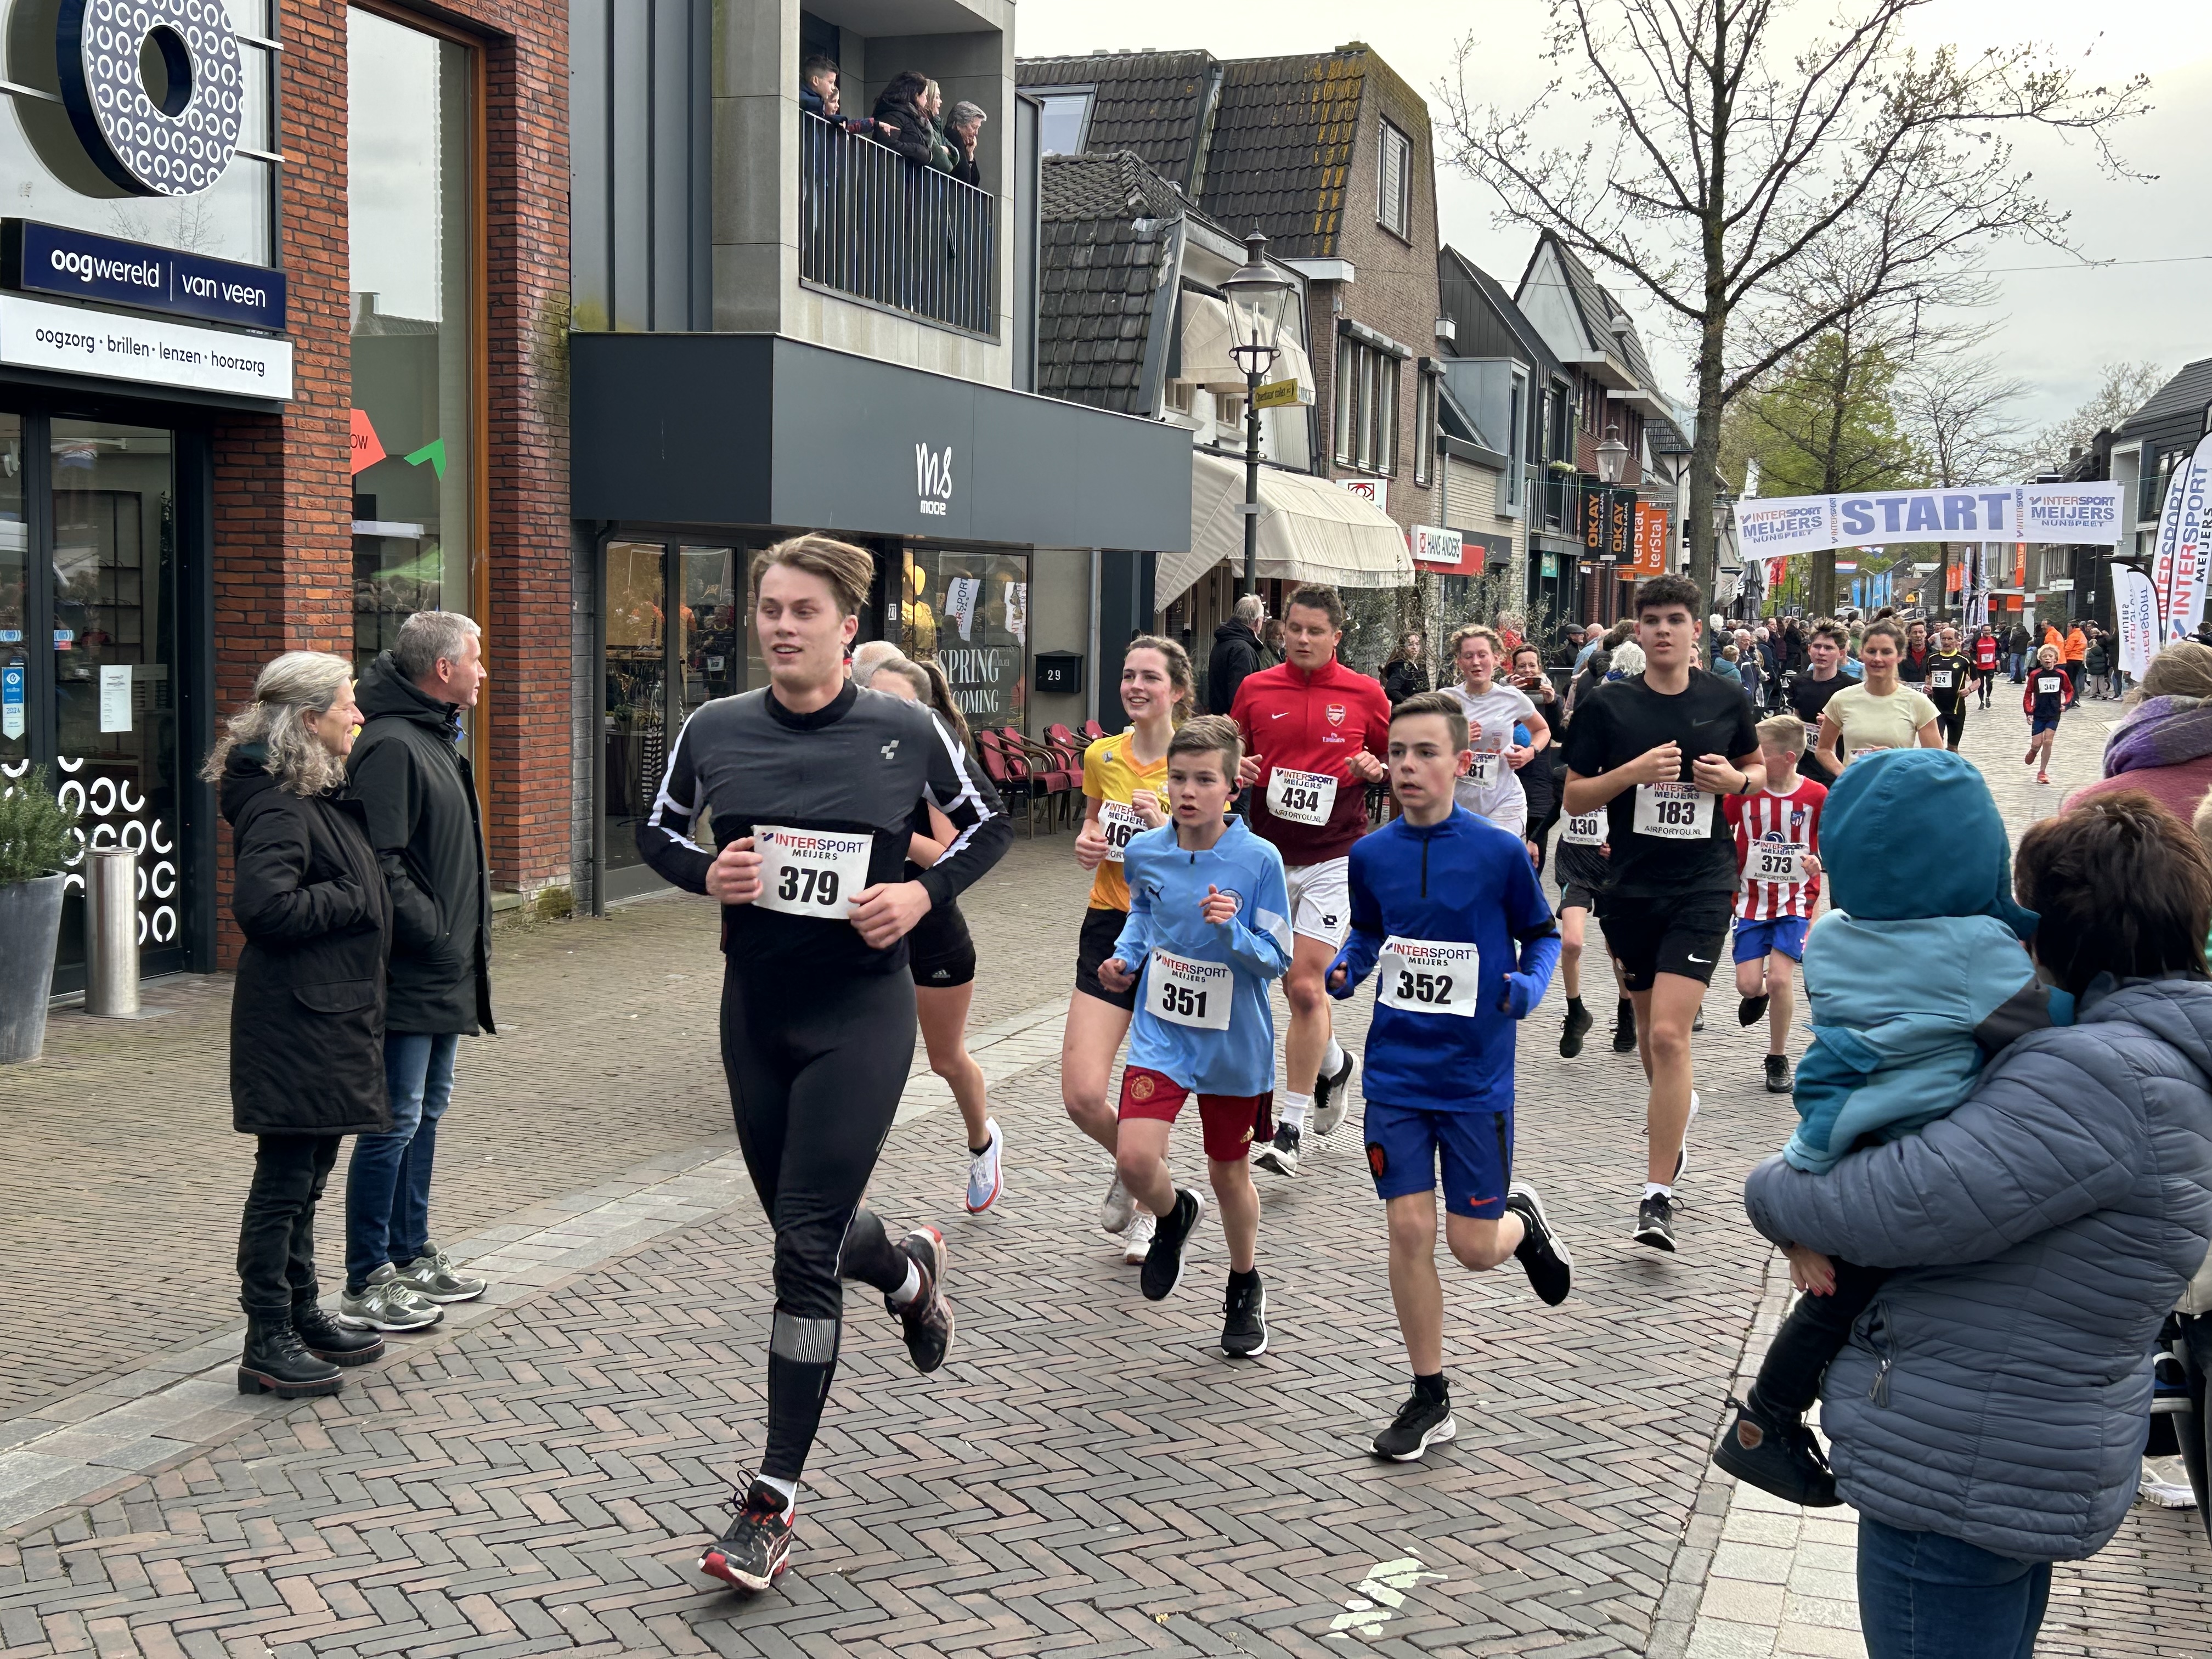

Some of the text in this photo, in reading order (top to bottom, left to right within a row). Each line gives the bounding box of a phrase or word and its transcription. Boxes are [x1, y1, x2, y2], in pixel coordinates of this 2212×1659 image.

[50, 249, 266, 308] oogwereld van veen
[35, 328, 265, 377] oogzorg brillen lenzen hoorzorg
[2043, 496, 2115, 506] INTERSPORT
[1588, 494, 1599, 548] OKAY
[1753, 506, 1822, 523] INTERSPORT
[1841, 492, 2011, 536] START
[2031, 506, 2115, 520] MEIJERS
[1612, 503, 1624, 552] OKAY
[1742, 516, 1822, 538] MEIJERS
[2172, 458, 2208, 616] INTERSPORT
[1649, 518, 1662, 568] terStal
[938, 648, 999, 684] SPRING
[1047, 669, 1061, 680] 29
[1284, 770, 1334, 785] INTERSPORT
[1284, 778, 1322, 789] MEIJERS
[1281, 787, 1319, 812] 434
[1655, 791, 1700, 799] MEIJERS
[1656, 801, 1695, 825] 183
[1104, 821, 1145, 848] 46
[1569, 818, 1598, 836] 430
[775, 833, 865, 854] INTERSPORT
[792, 849, 838, 860] MEIJERS
[1762, 855, 1792, 873] 373
[778, 866, 839, 906] 379
[1393, 943, 1472, 960] INTERSPORT
[1408, 956, 1448, 966] MEIJERS
[1161, 955, 1229, 978] INTERSPORT
[1171, 970, 1206, 983] MEIJERS
[1397, 969, 1453, 1005] 352
[1162, 983, 1207, 1018] 351
